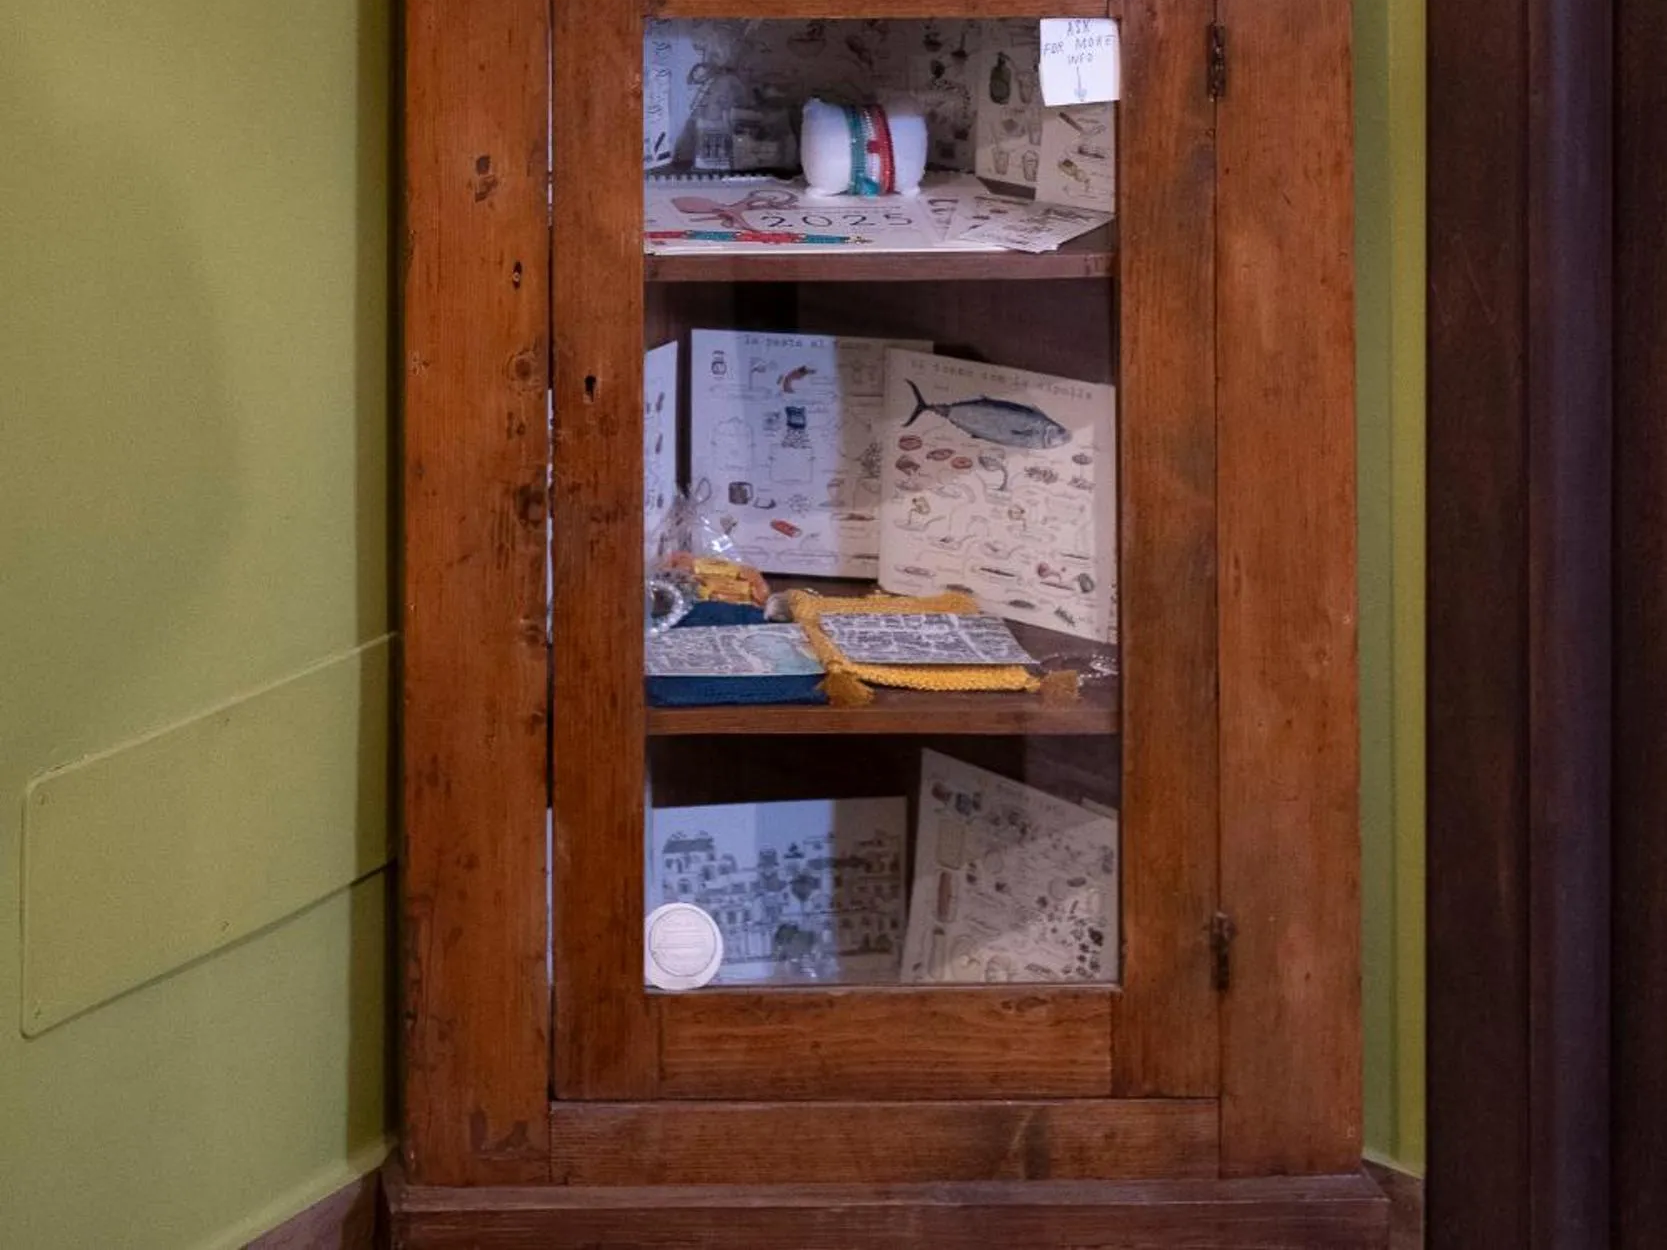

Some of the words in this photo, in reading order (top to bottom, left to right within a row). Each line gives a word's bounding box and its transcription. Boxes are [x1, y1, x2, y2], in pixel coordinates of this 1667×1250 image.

[1067, 19, 1092, 36] ASK
[1043, 41, 1065, 55] FOR
[1075, 35, 1117, 51] MORE
[1067, 52, 1094, 65] INFO
[760, 213, 913, 228] 2025
